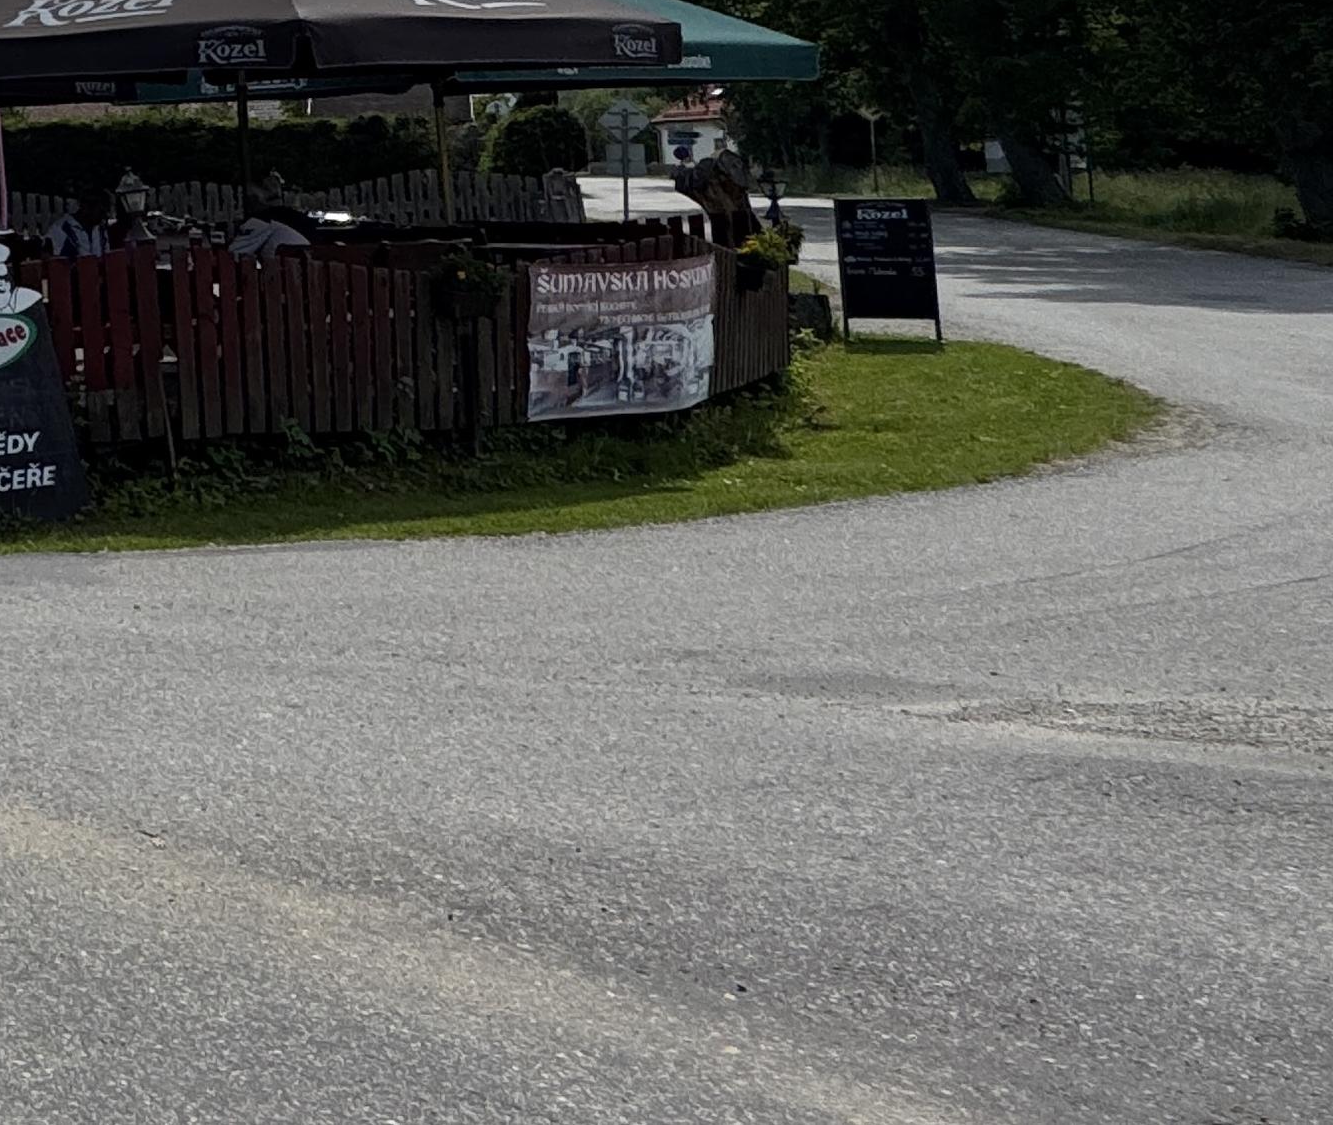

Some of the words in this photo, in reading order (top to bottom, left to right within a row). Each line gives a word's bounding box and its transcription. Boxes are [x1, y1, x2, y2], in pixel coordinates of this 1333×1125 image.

[197, 39, 268, 64] Kozel
[614, 35, 658, 58] Kozel
[856, 208, 909, 220] Kozel
[536, 265, 650, 294] ŠUMAVSKÁ
